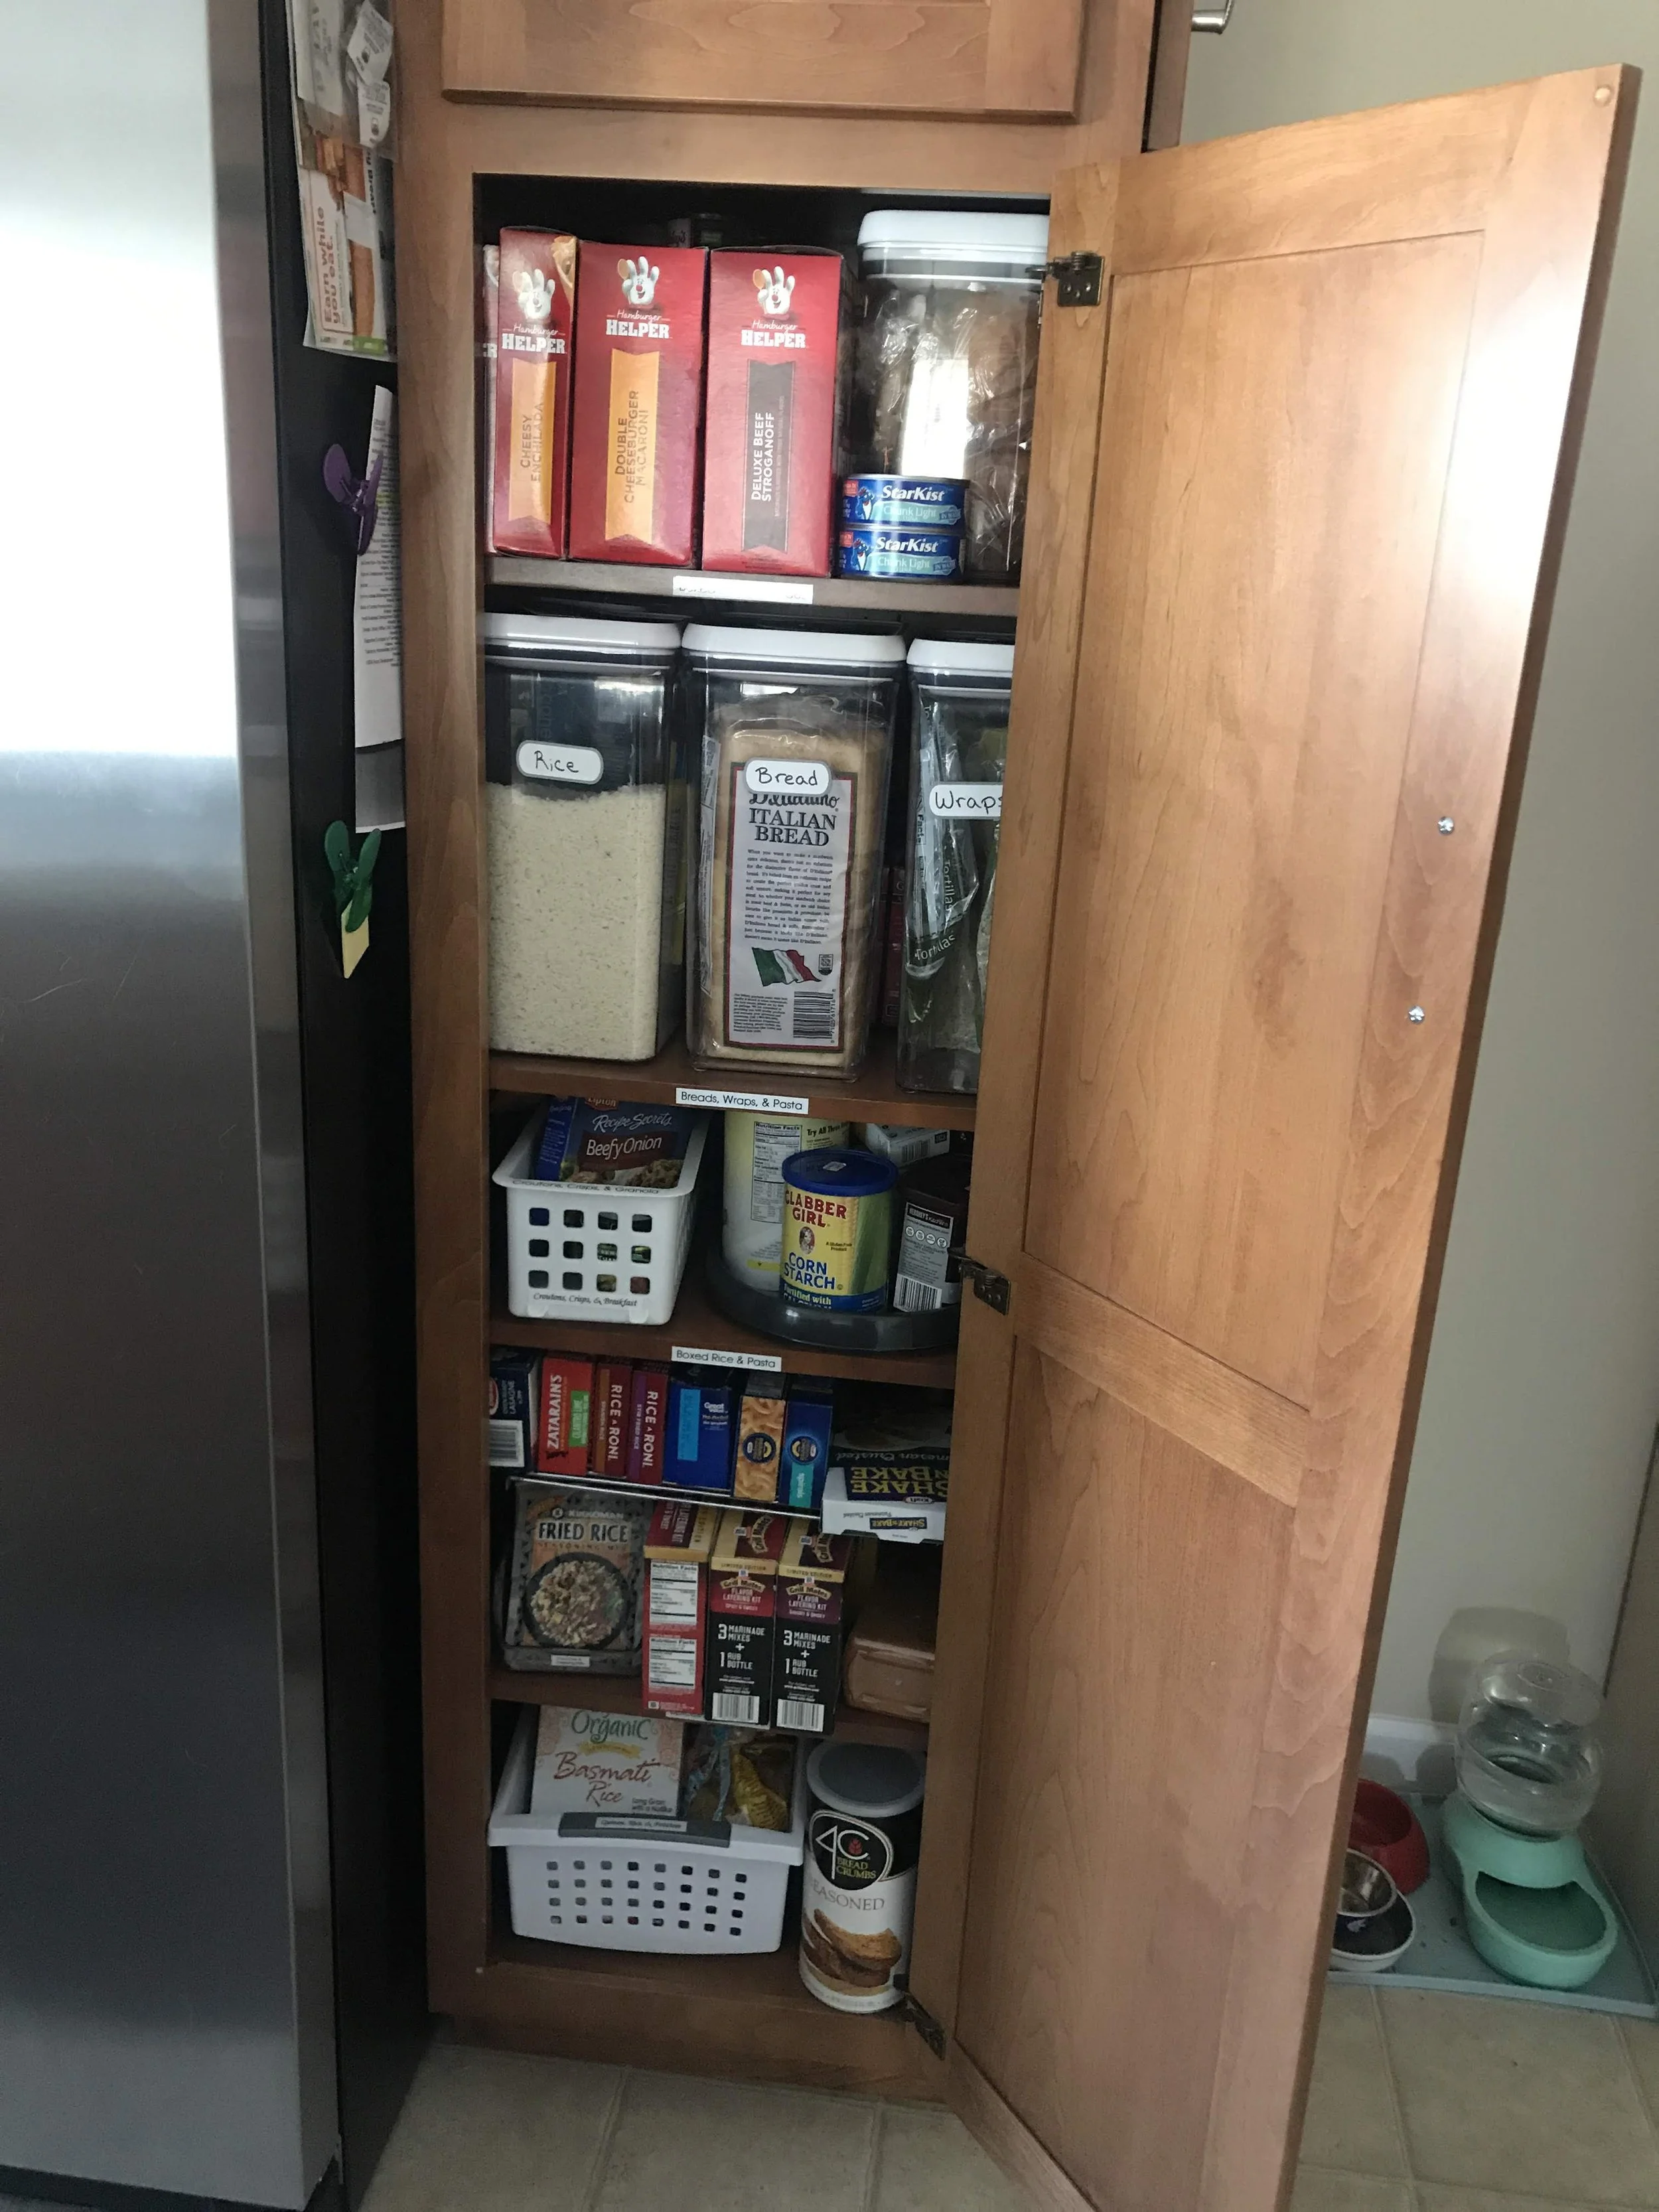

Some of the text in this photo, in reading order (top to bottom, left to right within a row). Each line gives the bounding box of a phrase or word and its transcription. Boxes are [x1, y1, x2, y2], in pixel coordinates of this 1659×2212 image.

[317, 206, 327, 265] while
[323, 273, 332, 323] Earn
[332, 285, 340, 324] you
[616, 309, 662, 321] Hamburger
[514, 323, 559, 338] Hamburger
[606, 319, 669, 338] HELPER
[752, 320, 798, 332] Hamburger
[502, 333, 565, 354] HELPER
[741, 330, 806, 348] HELPER
[520, 415, 533, 469] CHEESY
[531, 403, 544, 482] ENCHILADA
[615, 417, 627, 475] DOUBLE
[624, 391, 639, 503] CHEESEBURGER
[636, 409, 649, 486] MACARONI
[751, 413, 764, 500] DELUXE BEEF
[761, 412, 774, 502] STROGANOFF
[881, 485, 945, 501] StarKist
[883, 504, 936, 518] Chunk Light
[875, 537, 939, 553] StarKist
[877, 557, 930, 571] Chunk Light
[534, 751, 579, 773] Rice
[755, 767, 818, 786] Bread
[749, 808, 837, 830] ITALIAN
[755, 826, 829, 846] BREAD
[915, 935, 956, 960] Tortillas
[681, 1091, 802, 1110] Breads, Wraps, & Pasta
[593, 1112, 672, 1133] Recipe Secrets
[587, 1138, 624, 1160] Beefy
[624, 1135, 662, 1153] Onion
[512, 1179, 563, 1189] Croutons,
[785, 1190, 847, 1219] CLABBER
[792, 1207, 826, 1228] GIRL
[789, 1252, 827, 1276] CORN
[784, 1262, 835, 1290] STARCH
[593, 1296, 603, 1305] &
[604, 1297, 638, 1307] Breakfast
[812, 1296, 831, 1305] with
[677, 1349, 709, 1361] Boxed
[711, 1353, 733, 1363] Rice
[747, 1357, 775, 1368] Pasta
[610, 1384, 622, 1417] RICE
[645, 1391, 658, 1424] RICE
[607, 1427, 620, 1460] RONI
[642, 1434, 655, 1467] RONI
[836, 1452, 895, 1461] Crusted
[851, 1466, 933, 1481] BAKE
[796, 1473, 806, 1499] spirals
[850, 1479, 948, 1498] SHAKE
[539, 1522, 628, 1543] FRIED RICE
[724, 1580, 739, 1588] Grill
[731, 1588, 753, 1597] FLAVOR
[723, 1594, 751, 1603] LAYERING
[788, 1600, 816, 1610] LAYERING
[718, 1623, 766, 1640] 3 MARINADE
[728, 1633, 751, 1643] MIXES
[783, 1630, 831, 1646] 3 MARINADE
[794, 1639, 816, 1650] MIXES
[720, 1652, 742, 1667] 1 RUB
[727, 1660, 753, 1670] BOTTLE
[786, 1658, 807, 1674] 1 RUB
[792, 1667, 818, 1678] BOTTLE
[571, 1710, 651, 1744] Organic
[553, 1751, 661, 1783] Basmati
[586, 1780, 624, 1807] Rice
[816, 1825, 869, 1880] 4C
[836, 1856, 869, 1870] BREAD
[836, 1866, 877, 1880] CRUMBS
[811, 1880, 885, 1911] EASONED
